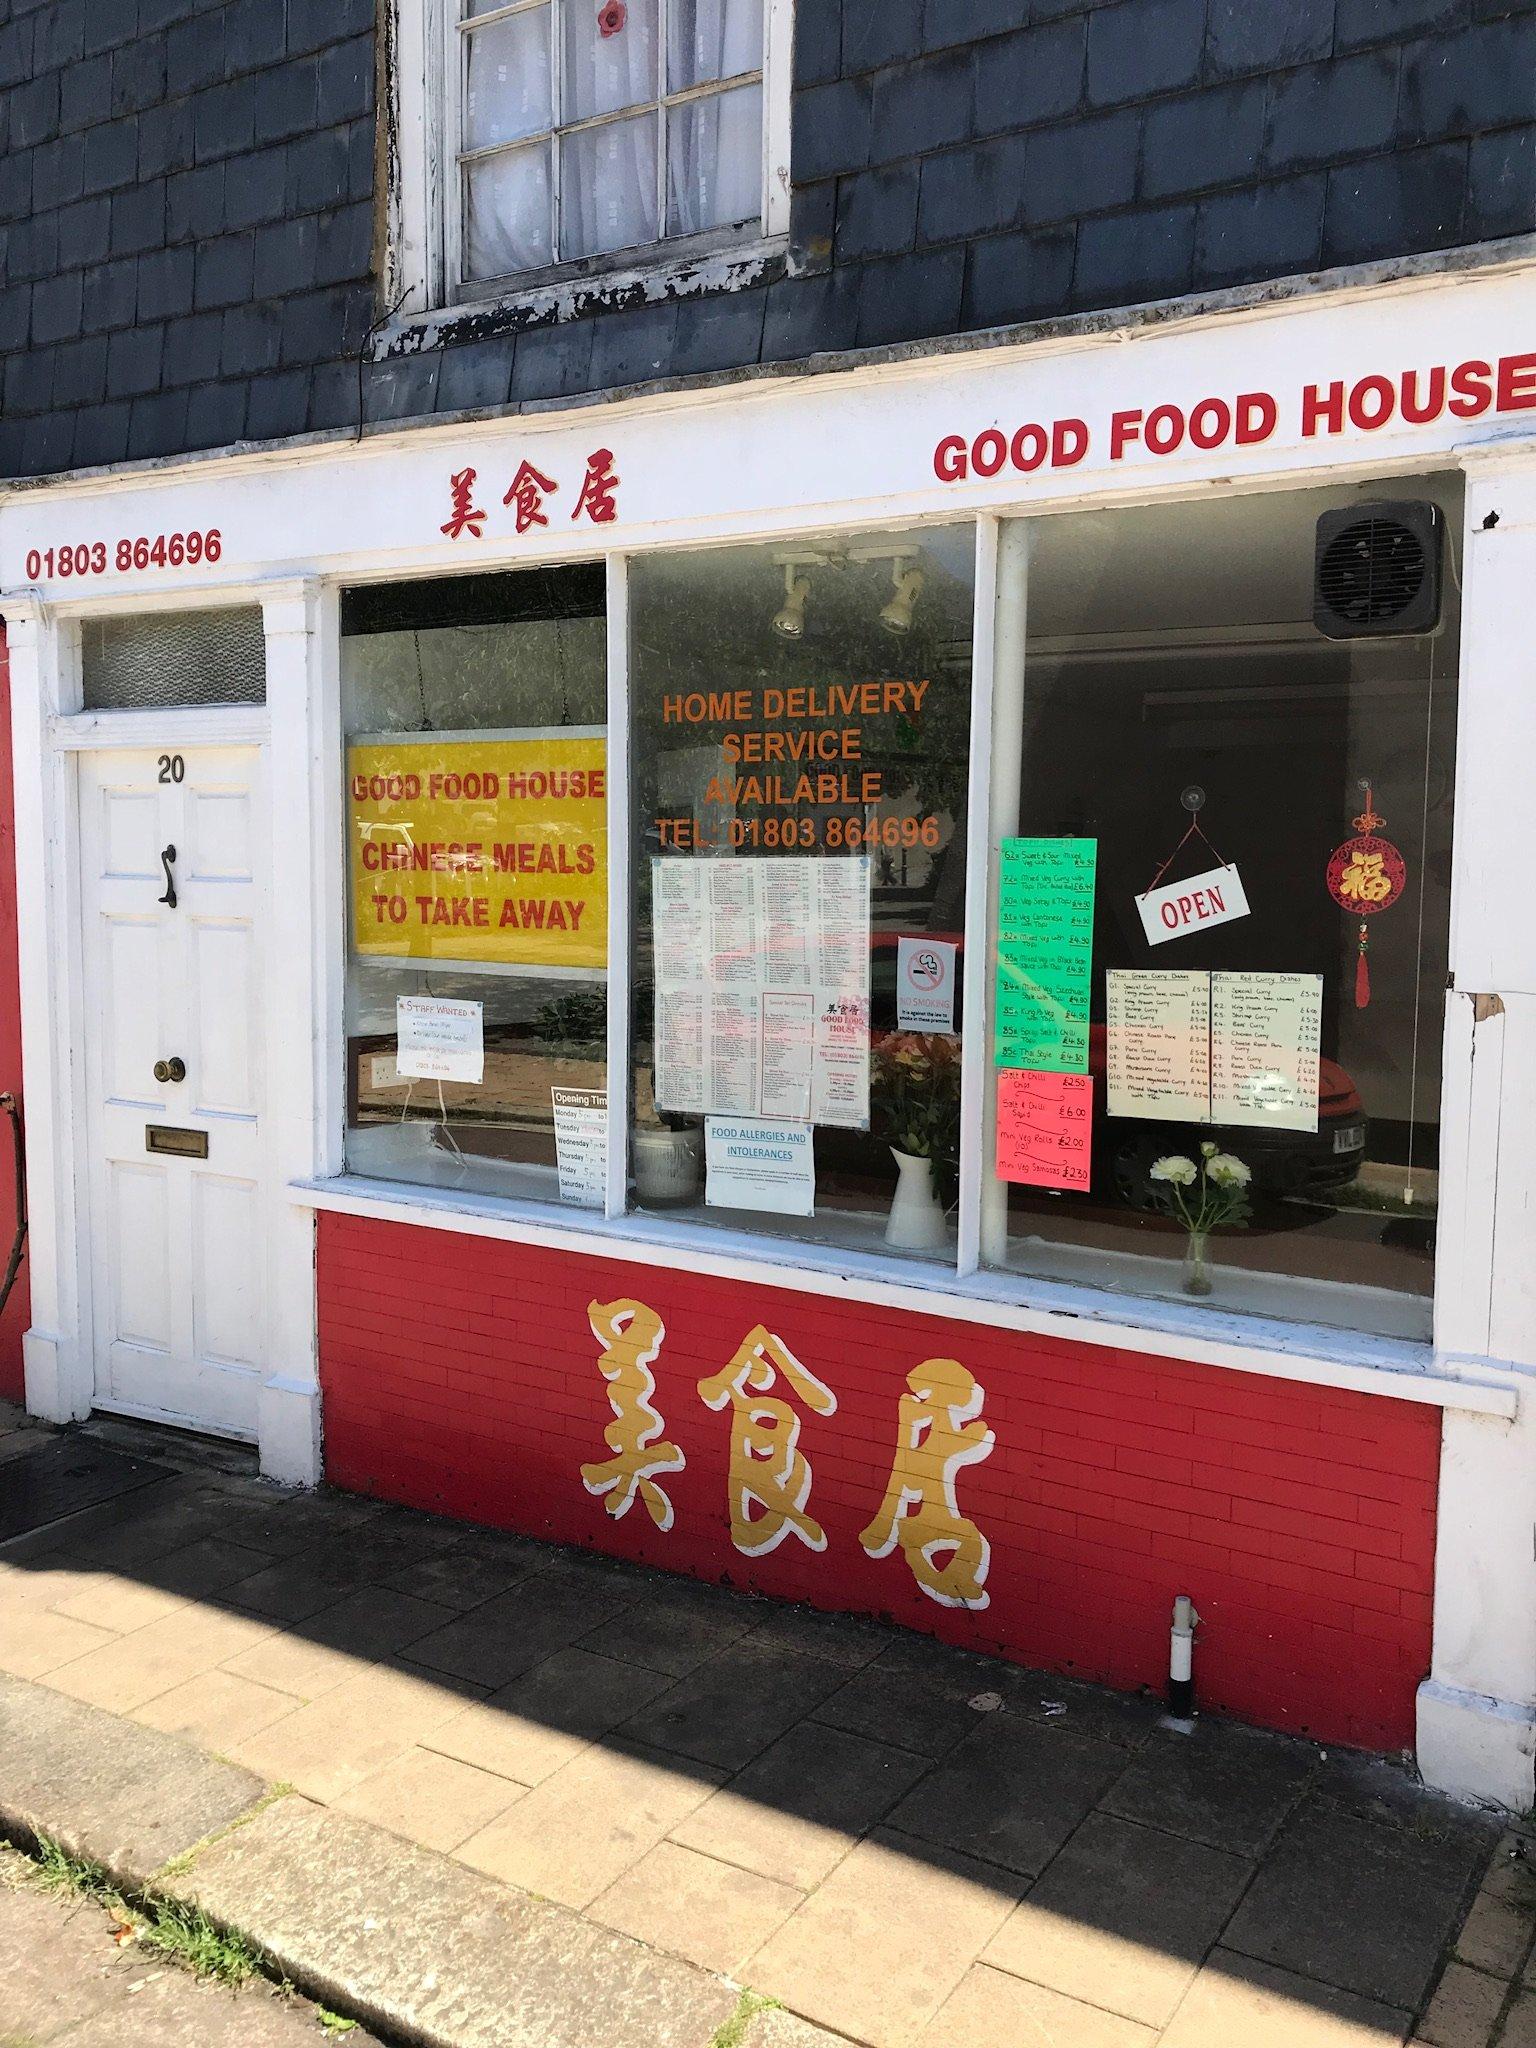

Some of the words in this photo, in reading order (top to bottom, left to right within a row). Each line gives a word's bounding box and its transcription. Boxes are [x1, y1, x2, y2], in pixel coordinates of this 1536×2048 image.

[933, 418, 1090, 483] GOOD
[1110, 392, 1277, 460] FOOD
[1301, 353, 1536, 437] HOUSE
[440, 448, 620, 539] 美食居
[26, 541, 107, 580] 01803
[115, 529, 222, 572] 864696
[663, 690, 753, 724] HOME
[763, 680, 930, 720] DELIVERY
[722, 727, 863, 764] SERVICE
[158, 754, 184, 783] 20
[352, 775, 421, 801] GOOD
[430, 773, 500, 800] FOOD
[513, 770, 606, 799] HOUSE
[704, 773, 882, 805] AVAILABLE
[727, 818, 815, 848] 01803
[826, 816, 939, 848] 864696
[363, 842, 484, 873] CHINESE
[494, 843, 595, 874] MEALS
[372, 895, 408, 923] TO
[416, 896, 490, 927] TAKE
[500, 899, 586, 931] AWAY
[1161, 885, 1226, 929] OPEN
[913, 998, 950, 1008] SMOKING
[437, 1005, 468, 1017] WANTED
[1002, 1069, 1019, 1079] Salt
[556, 1093, 589, 1107] Opening
[1003, 1099, 1019, 1108] Salt
[556, 1109, 577, 1119] Monday
[557, 1122, 579, 1132] Tuesday
[558, 1138, 589, 1148] Wednesday
[712, 1128, 737, 1138] FOOD
[740, 1129, 786, 1142] ALLERGIES
[787, 1133, 806, 1143] AND
[559, 1151, 584, 1161] Thursday
[727, 1146, 793, 1160] INTOLERANCES
[560, 1165, 577, 1175] Friday
[561, 1179, 585, 1190] Saturday
[562, 1193, 582, 1203] Sunday
[580, 1297, 996, 1611] 美食居
